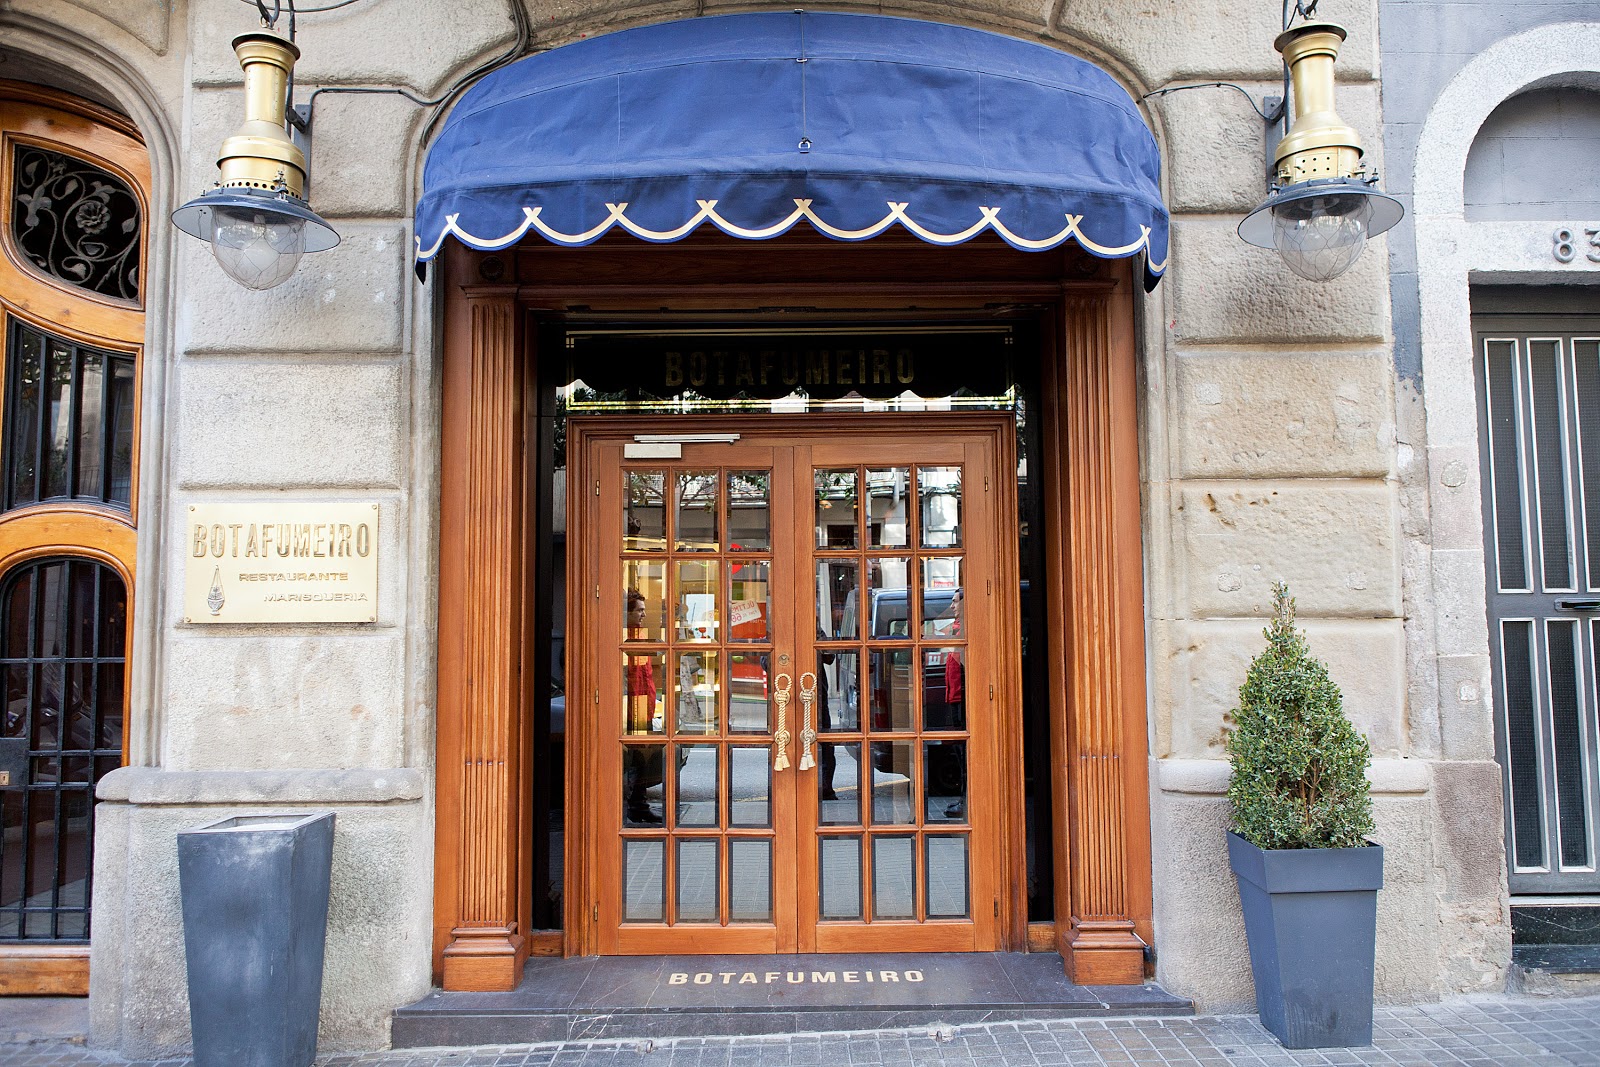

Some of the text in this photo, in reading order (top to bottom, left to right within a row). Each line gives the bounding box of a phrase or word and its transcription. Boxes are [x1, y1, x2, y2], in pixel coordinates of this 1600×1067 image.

[1552, 226, 1600, 263] 83
[665, 350, 915, 386] BOTAFUMEIRO
[193, 523, 371, 558] BOTAFUMEIRO
[239, 571, 349, 582] RESTAURANTE
[263, 592, 368, 602] MARISQUERIA
[668, 970, 924, 985] BOTAFUMEIRO
